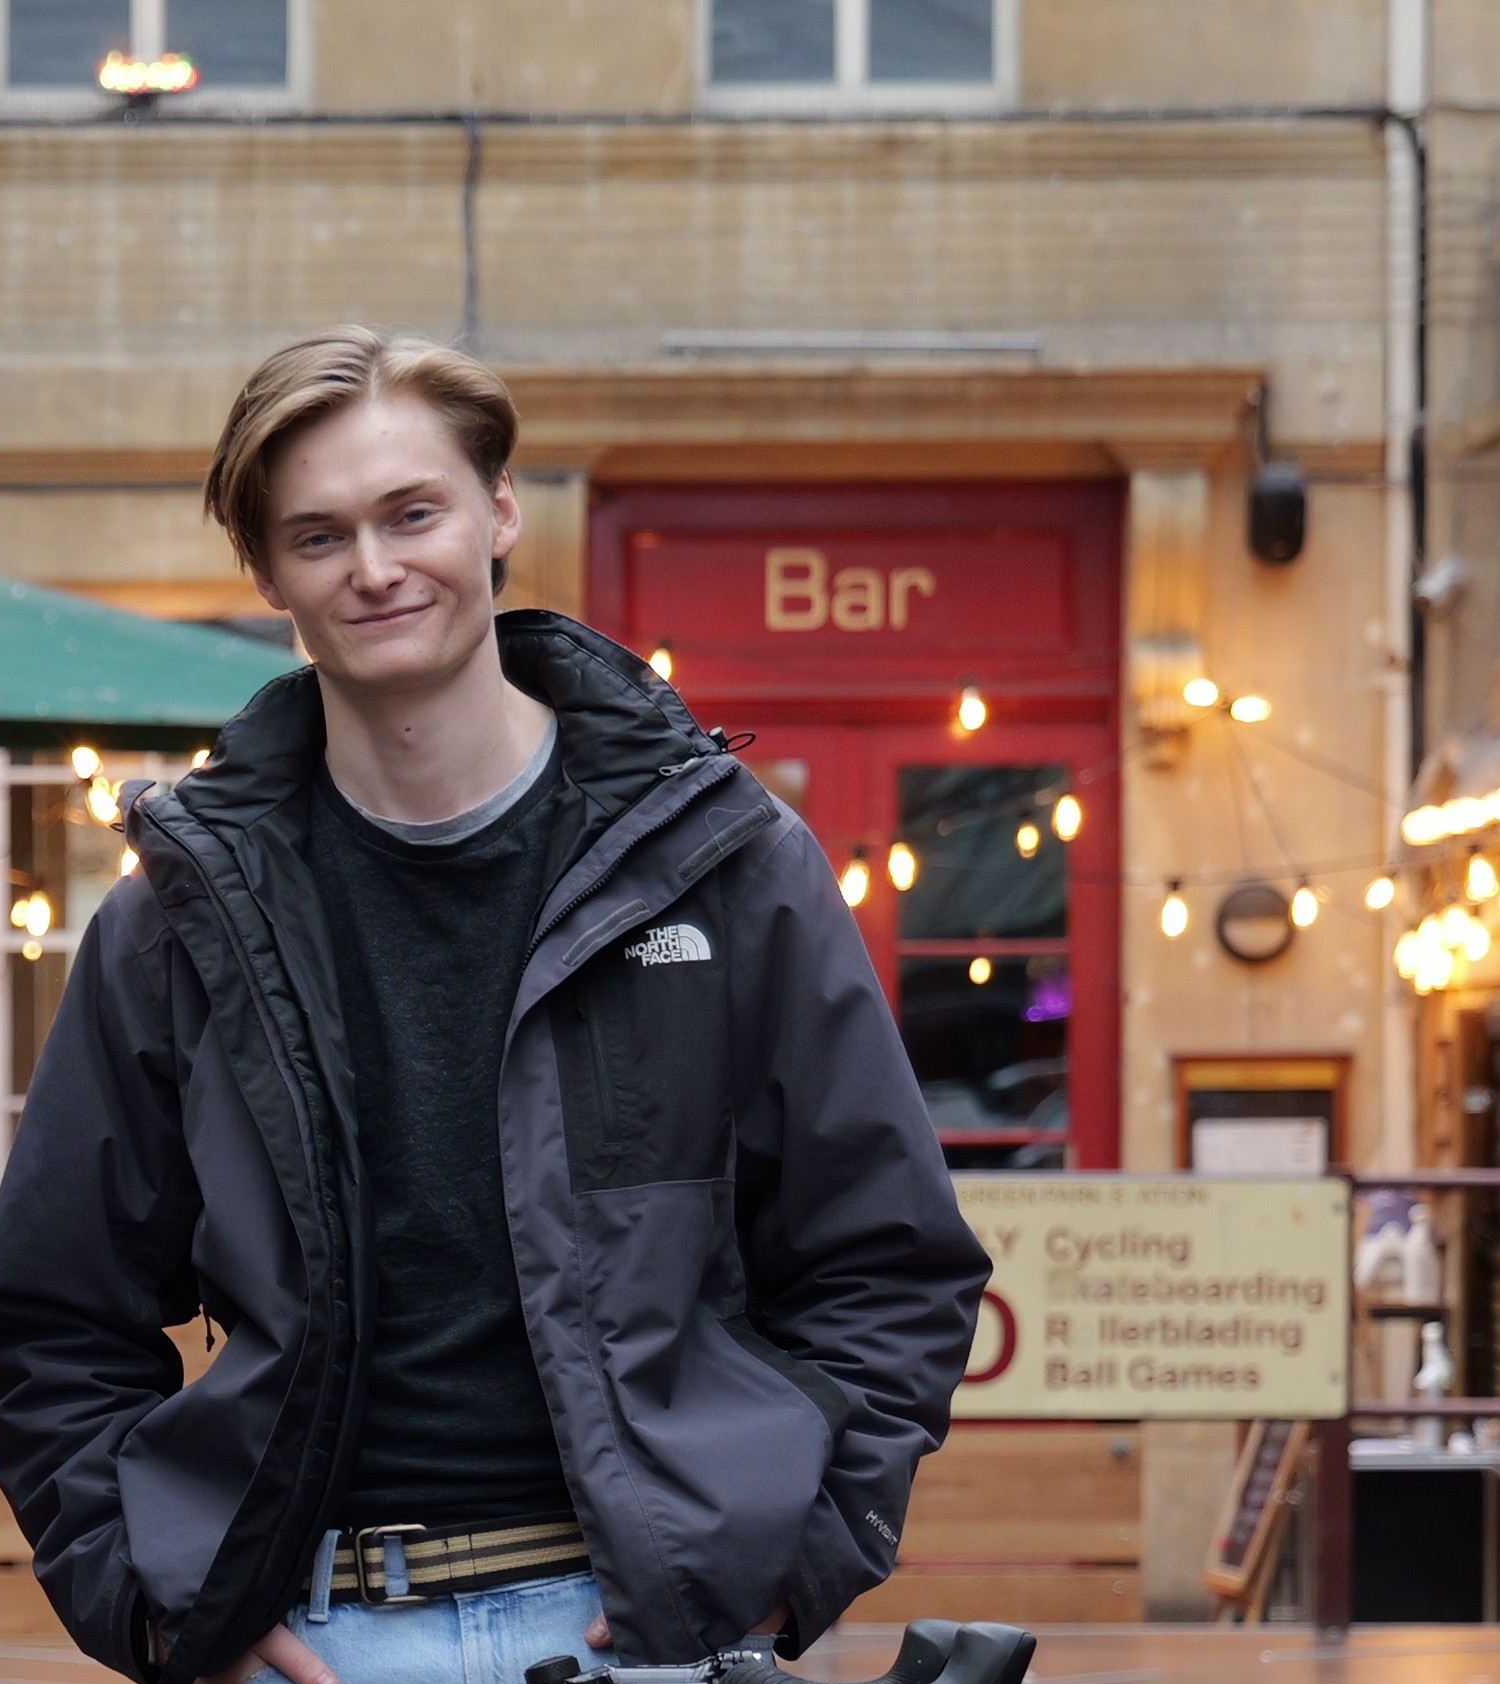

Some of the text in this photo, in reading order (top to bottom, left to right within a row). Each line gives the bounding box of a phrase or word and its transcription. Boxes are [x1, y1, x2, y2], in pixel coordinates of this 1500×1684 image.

[764, 547, 935, 633] Bar
[624, 937, 680, 959] NORTH
[645, 925, 679, 941] THE
[641, 949, 682, 967] FACE
[1045, 1225, 1192, 1269] Cycling
[1045, 1312, 1304, 1357] Rllerblading
[1045, 1354, 1263, 1391] Ball Games
